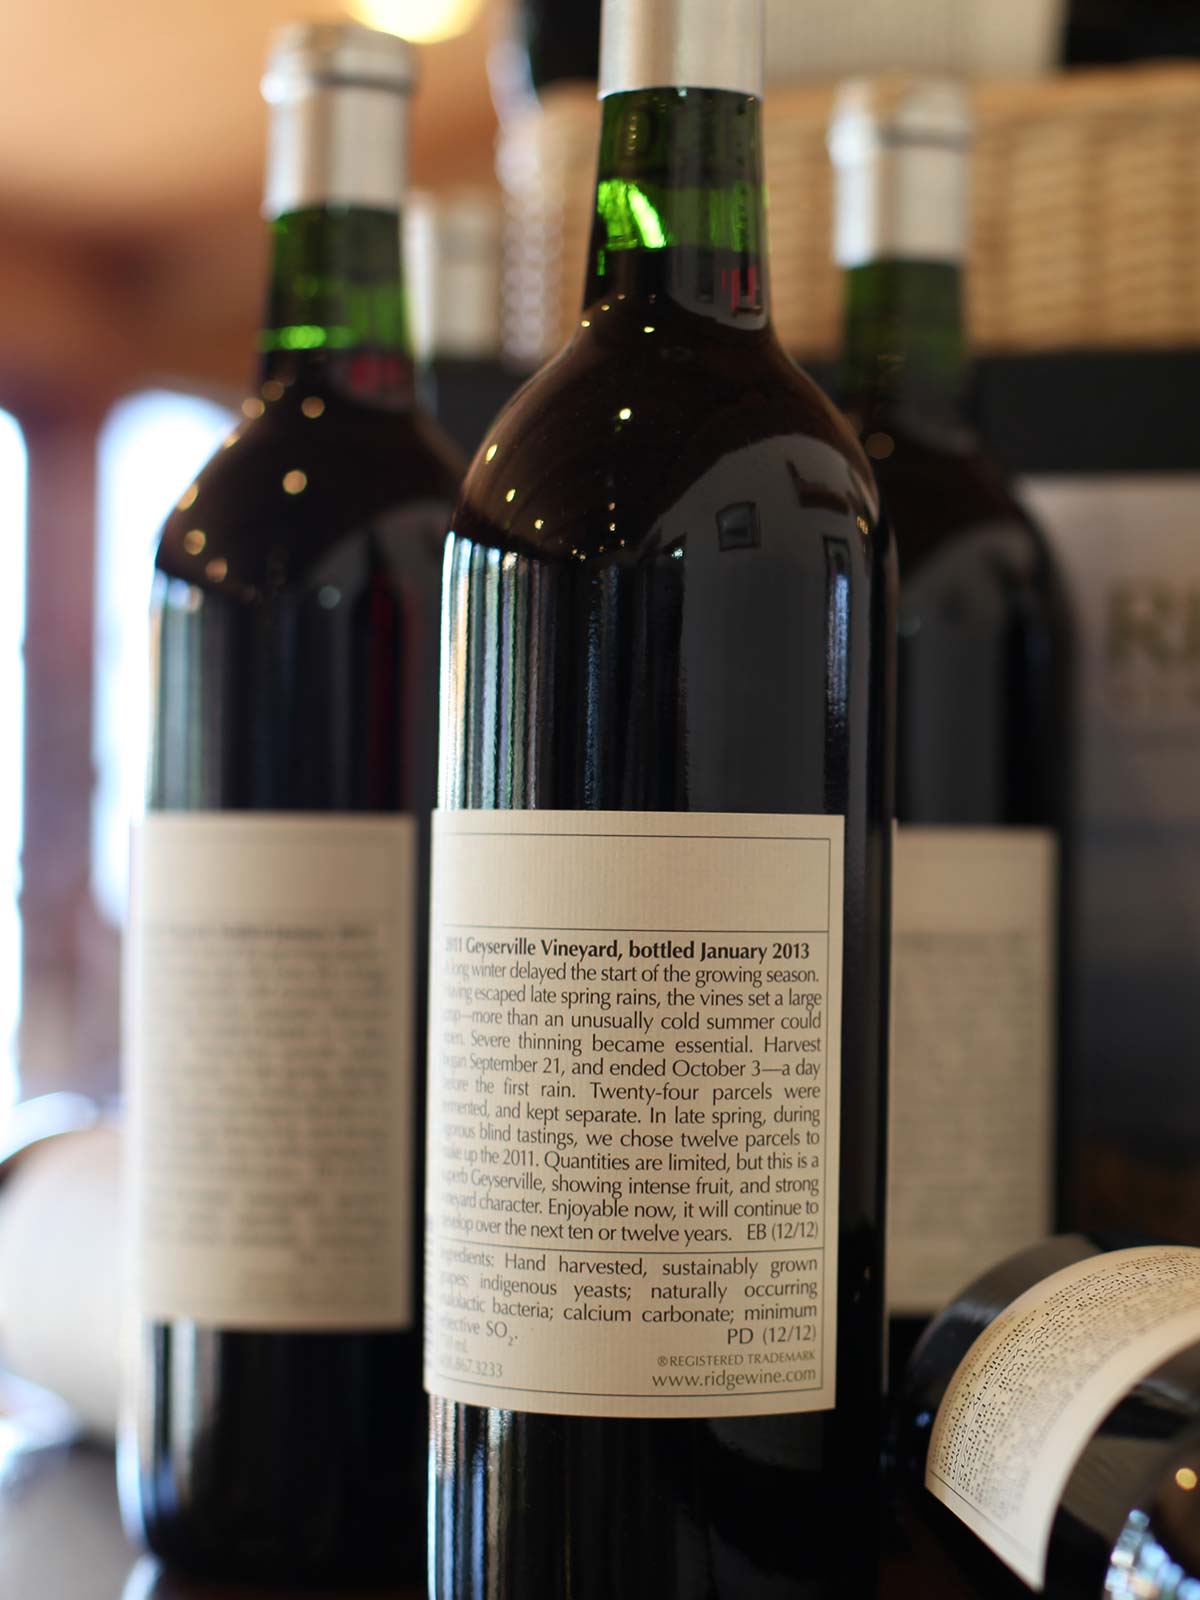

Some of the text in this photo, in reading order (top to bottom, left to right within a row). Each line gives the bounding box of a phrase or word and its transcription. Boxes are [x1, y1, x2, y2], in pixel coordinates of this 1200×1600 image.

[466, 937, 535, 963] Geyserville
[541, 939, 623, 961] Vineyard,
[629, 940, 694, 959] bottled
[701, 942, 767, 964] January
[773, 943, 809, 959] 2013
[472, 962, 506, 977] winter
[510, 961, 566, 984] delayed
[571, 963, 596, 980] the
[601, 967, 636, 983] start
[642, 964, 660, 982] of
[664, 964, 691, 982] the
[695, 966, 762, 988] growing
[767, 970, 818, 982] season.
[475, 985, 526, 1006] escaped
[531, 986, 556, 1003] late
[561, 988, 611, 1010] spring
[617, 992, 661, 1008] rains,
[667, 988, 695, 1005] the
[700, 990, 743, 1006] vines
[748, 992, 770, 1005] set
[775, 993, 783, 1005] a
[789, 988, 822, 1011] large
[507, 1008, 538, 1025] than
[545, 1014, 563, 1027] an
[571, 1012, 653, 1034] unusually
[661, 1011, 700, 1029] cold
[707, 1016, 775, 1029] summer
[781, 1011, 821, 1029] could
[471, 1030, 510, 1048] Severe
[519, 1033, 582, 1056] thinning
[592, 1034, 664, 1052] became
[676, 1035, 752, 1053] essential.
[764, 1037, 821, 1052] Harvest
[470, 1053, 538, 1076] September
[543, 1058, 565, 1077] 21,
[572, 1058, 603, 1075] and
[610, 1058, 665, 1076] ended
[673, 1059, 746, 1077] October
[752, 1061, 790, 1076] 3—a
[796, 1058, 821, 1080] day
[475, 1076, 494, 1093] the
[504, 1077, 529, 1096] first
[541, 1082, 575, 1098] rain.
[590, 1082, 699, 1104] Twenty-four
[713, 1082, 772, 1106] parcels
[784, 1085, 821, 1099] were
[496, 1102, 520, 1119] and
[527, 1103, 559, 1125] kept
[565, 1108, 641, 1127] separate.
[650, 1107, 666, 1123] In
[675, 1107, 705, 1124] late
[712, 1107, 766, 1129] spring,
[774, 1105, 820, 1127] during
[479, 1122, 511, 1142] blind
[517, 1128, 577, 1149] tastings,
[586, 1134, 612, 1146] we
[620, 1128, 673, 1147] chose
[682, 1130, 738, 1147] twelve
[745, 1128, 800, 1152] parcels
[807, 1131, 820, 1144] to
[464, 1150, 477, 1166] up
[481, 1146, 499, 1162] the
[503, 1149, 539, 1167] 2011.
[544, 1151, 630, 1171] Quantities
[636, 1159, 662, 1170] are
[669, 1153, 730, 1173] limited,
[736, 1153, 763, 1170] but
[768, 1152, 793, 1169] this
[798, 1153, 808, 1168] is
[811, 1156, 819, 1168] a
[471, 1169, 546, 1193] Geyserville,
[552, 1174, 622, 1198] showing
[629, 1177, 690, 1194] intense
[697, 1176, 733, 1196] fruit,
[740, 1176, 770, 1194] and
[776, 1178, 819, 1196] strong
[479, 1193, 542, 1214] character.
[549, 1198, 629, 1223] Enjoyable
[635, 1204, 676, 1220] now,
[684, 1202, 694, 1217] it
[700, 1200, 728, 1217] will
[734, 1200, 801, 1217] continue
[806, 1202, 819, 1215] to
[476, 1221, 500, 1233] over
[505, 1218, 527, 1236] the
[531, 1223, 563, 1239] next
[569, 1226, 593, 1240] ten
[599, 1228, 616, 1240] or
[622, 1225, 679, 1241] twelve
[685, 1228, 732, 1247] years.
[748, 1224, 766, 1240] EB
[772, 1221, 818, 1242] (12/12)
[505, 1252, 545, 1271] Hand
[560, 1255, 647, 1278] harvested,
[663, 1257, 758, 1278] sustainably
[771, 1259, 818, 1277] grown
[480, 1273, 557, 1297] indigenous
[574, 1284, 631, 1302] yeasts;
[651, 1281, 728, 1304] naturally
[745, 1279, 817, 1298] occurring
[493, 1297, 553, 1321] bacteria;
[564, 1304, 631, 1321] calcium
[642, 1305, 734, 1324] carbonate;
[745, 1304, 817, 1321] minimum
[728, 1325, 816, 1345] PD (12/12)
[748, 1351, 815, 1364] TRADEMARK
[652, 1368, 816, 1390] www.ridgewine.com
